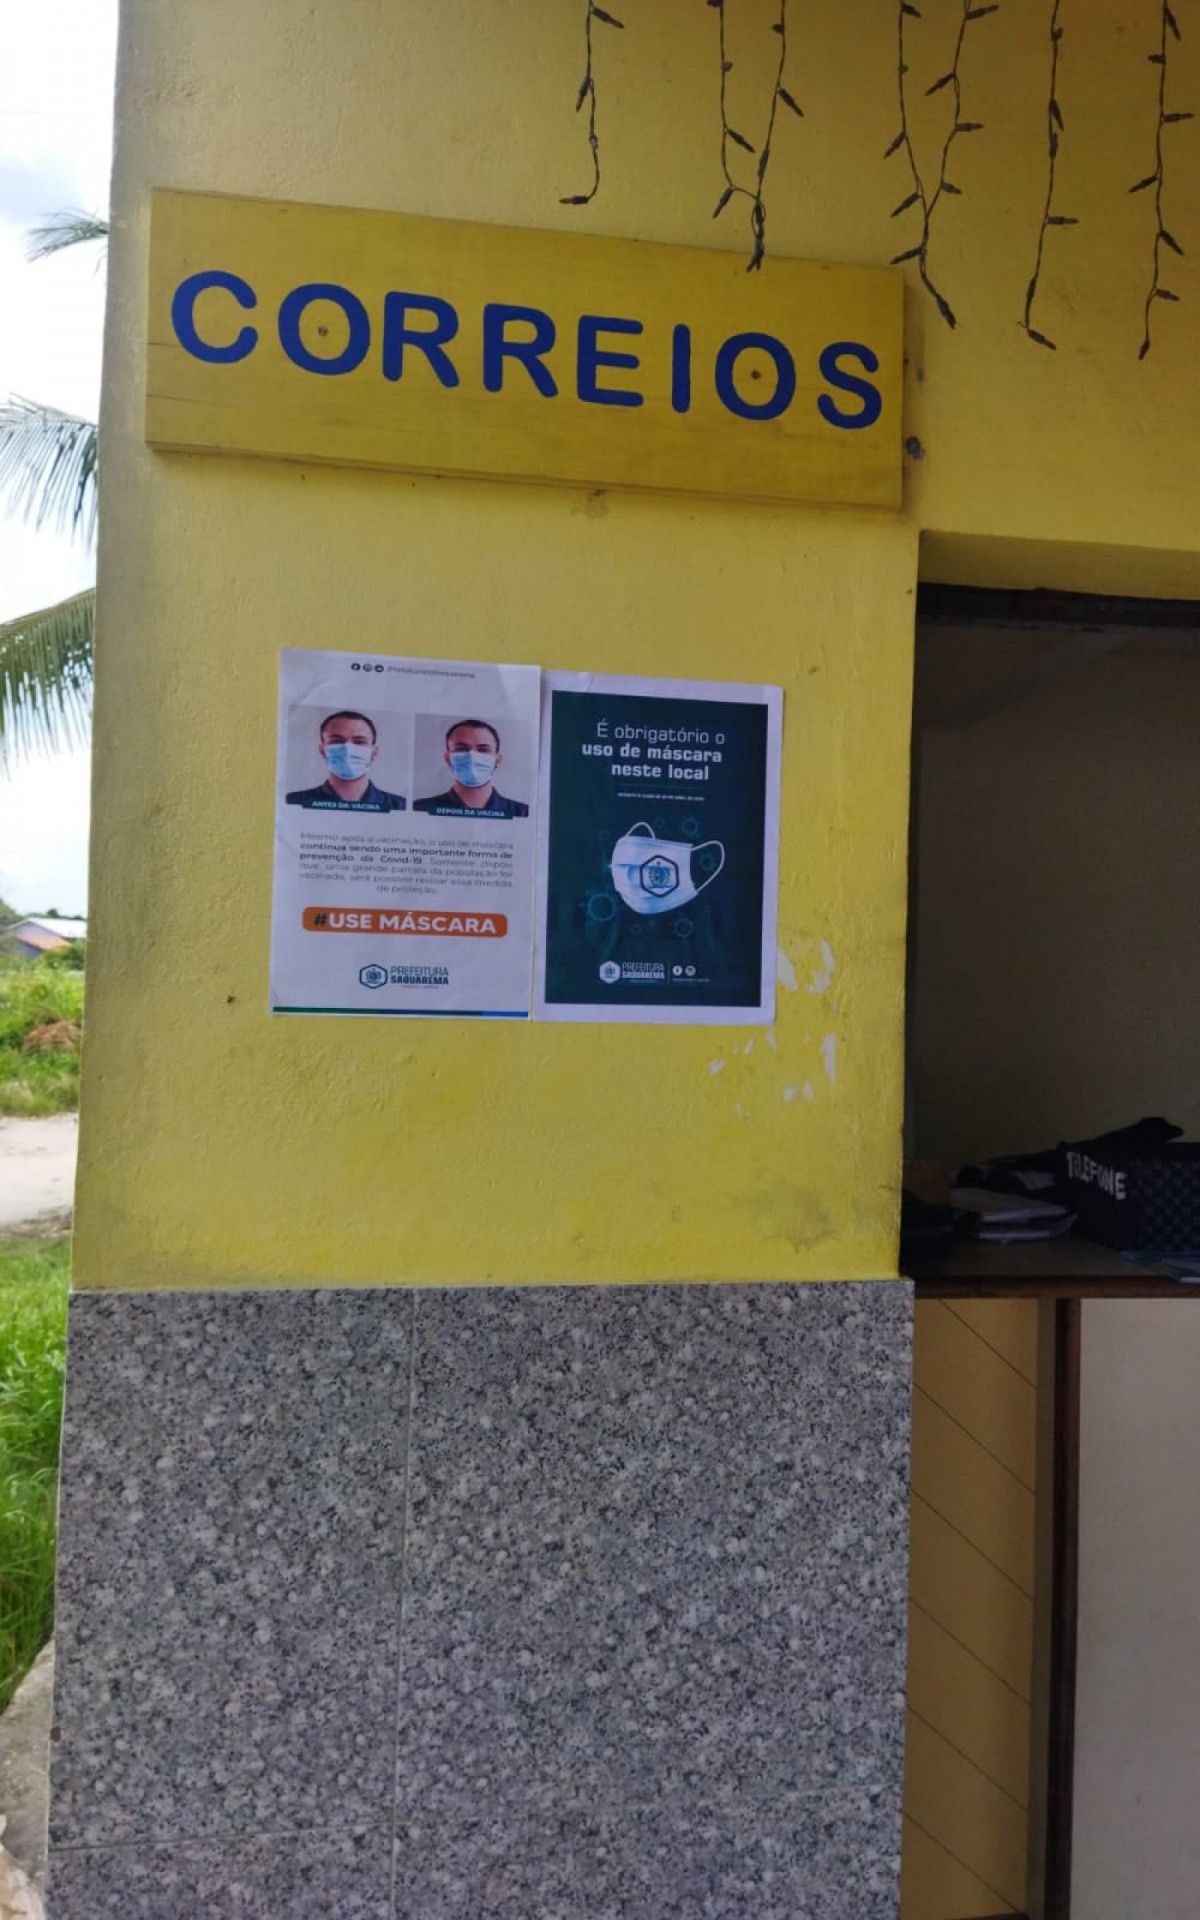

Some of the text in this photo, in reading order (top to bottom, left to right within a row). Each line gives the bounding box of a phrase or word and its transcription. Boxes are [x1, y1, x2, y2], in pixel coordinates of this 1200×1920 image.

[171, 270, 883, 429] CORREIOS
[597, 718, 726, 745] É obrigatório o
[581, 742, 723, 763] uso de máscara
[611, 763, 709, 781] neste local
[311, 800, 337, 808] ANTES
[299, 843, 347, 851] continua
[348, 844, 381, 853] sendo
[408, 847, 465, 857] importante
[467, 849, 498, 858] forma
[500, 850, 513, 859] de
[299, 853, 354, 862] prevenção
[360, 854, 374, 862] da
[313, 911, 497, 933] #USE MÁSCARA
[390, 966, 449, 977] PREFEITURA
[622, 962, 665, 972] PREFEITURA
[390, 975, 449, 985] SAQUAREMA
[1065, 1151, 1129, 1201] TELEFONE
